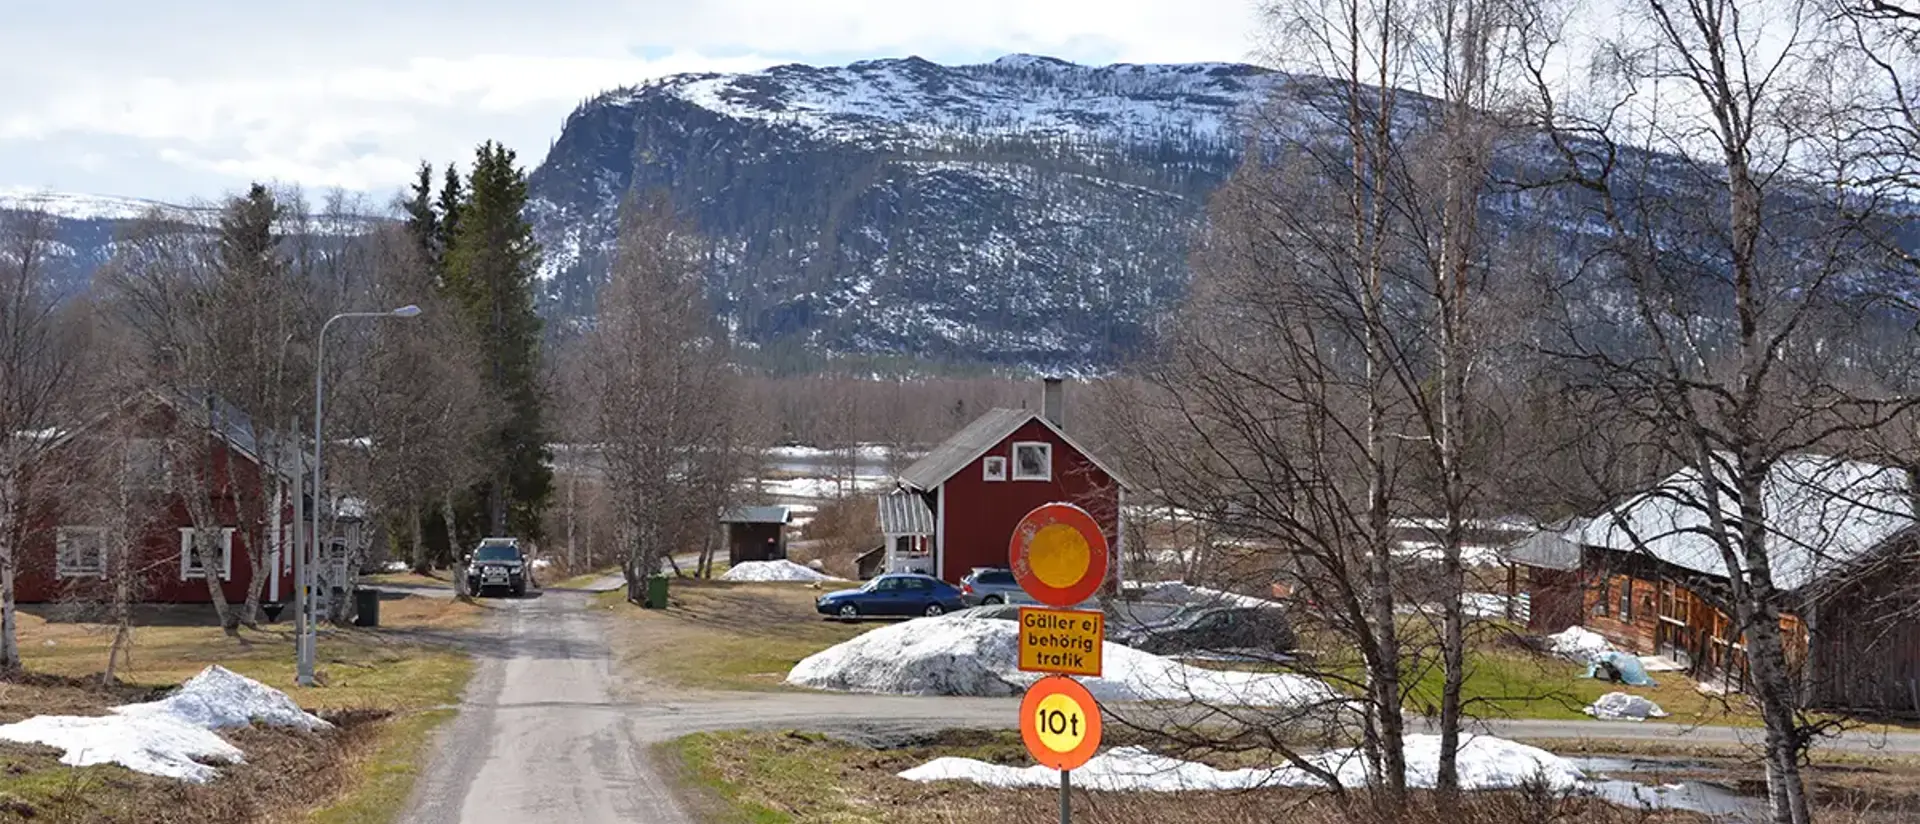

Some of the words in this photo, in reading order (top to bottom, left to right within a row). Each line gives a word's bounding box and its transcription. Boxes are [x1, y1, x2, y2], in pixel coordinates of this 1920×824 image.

[1024, 613, 1076, 630] Gäller
[1082, 617, 1098, 634] ej
[1028, 632, 1093, 653] behörig
[1037, 652, 1083, 668] trafik
